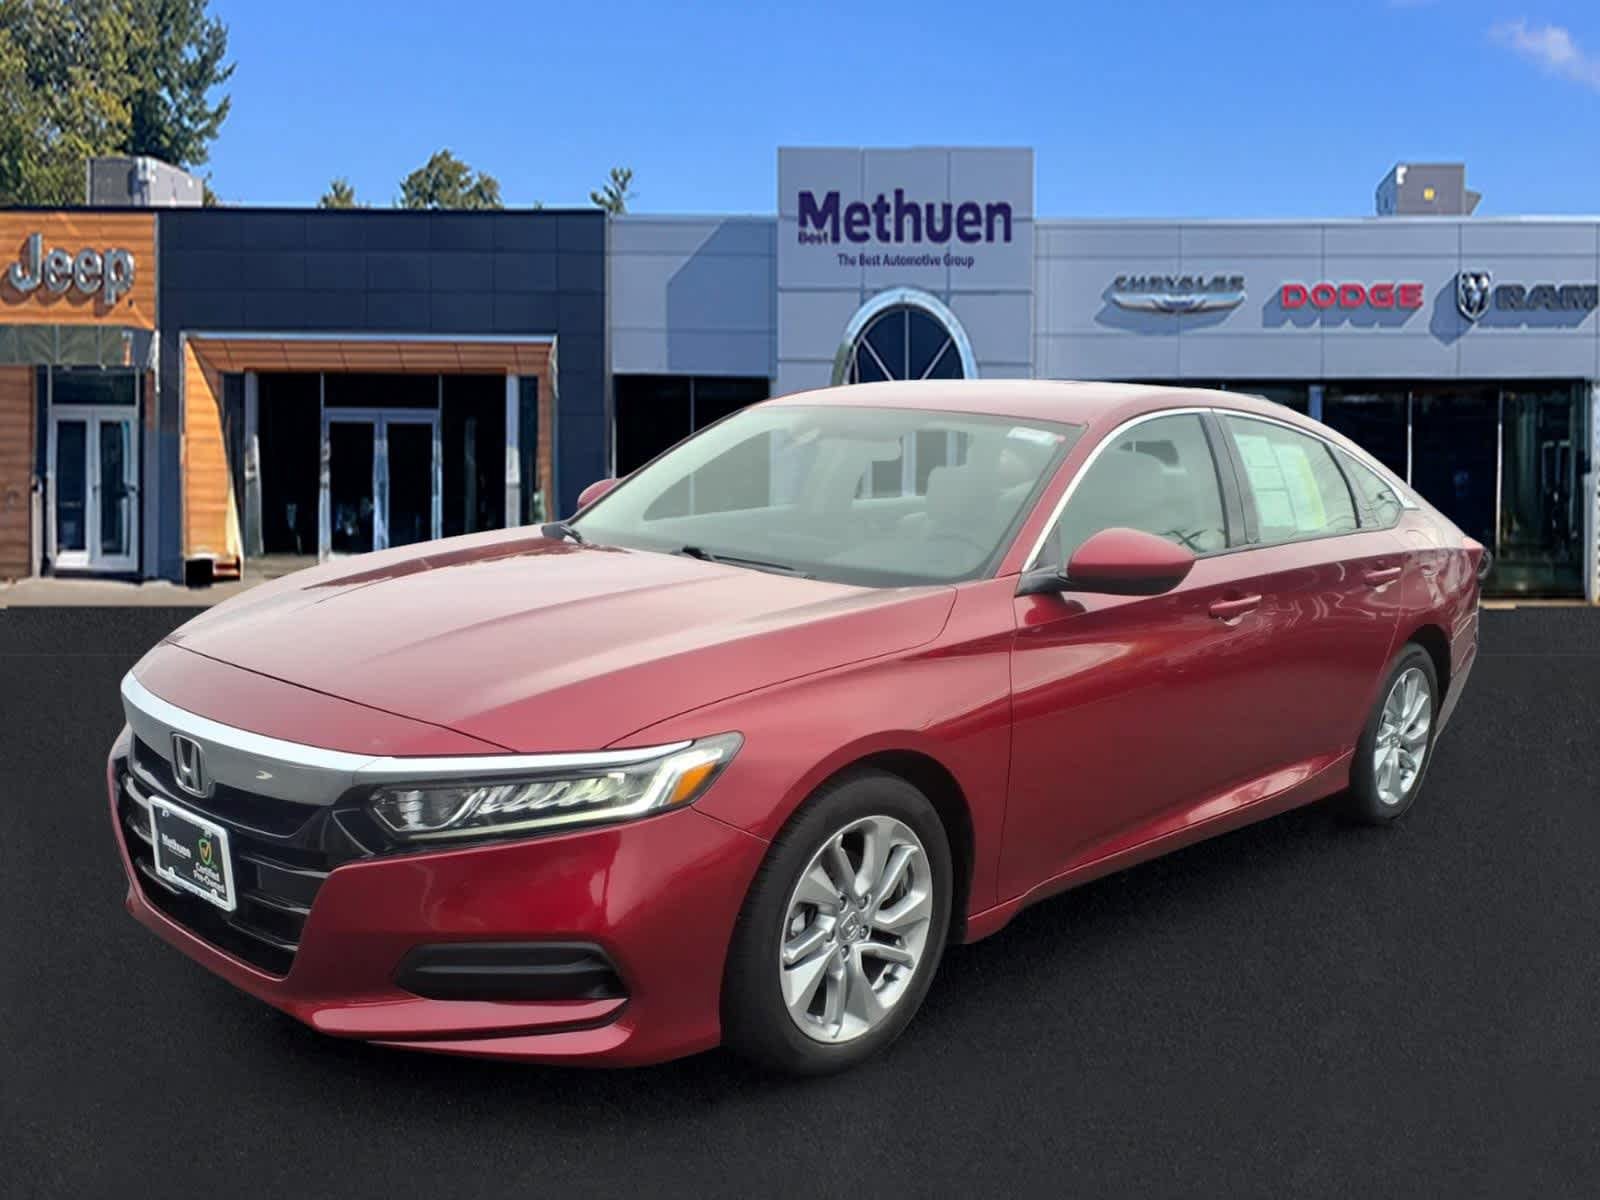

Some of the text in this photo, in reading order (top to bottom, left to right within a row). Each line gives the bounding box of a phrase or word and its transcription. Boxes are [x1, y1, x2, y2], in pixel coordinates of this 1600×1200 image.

[798, 188, 1012, 243] Methuen
[9, 232, 135, 305] Jeep
[837, 253, 975, 269] The Best Automotive Group
[1114, 275, 1246, 292] CHRYSLER
[1281, 283, 1425, 308] DODGE
[1495, 284, 1598, 311] RAM
